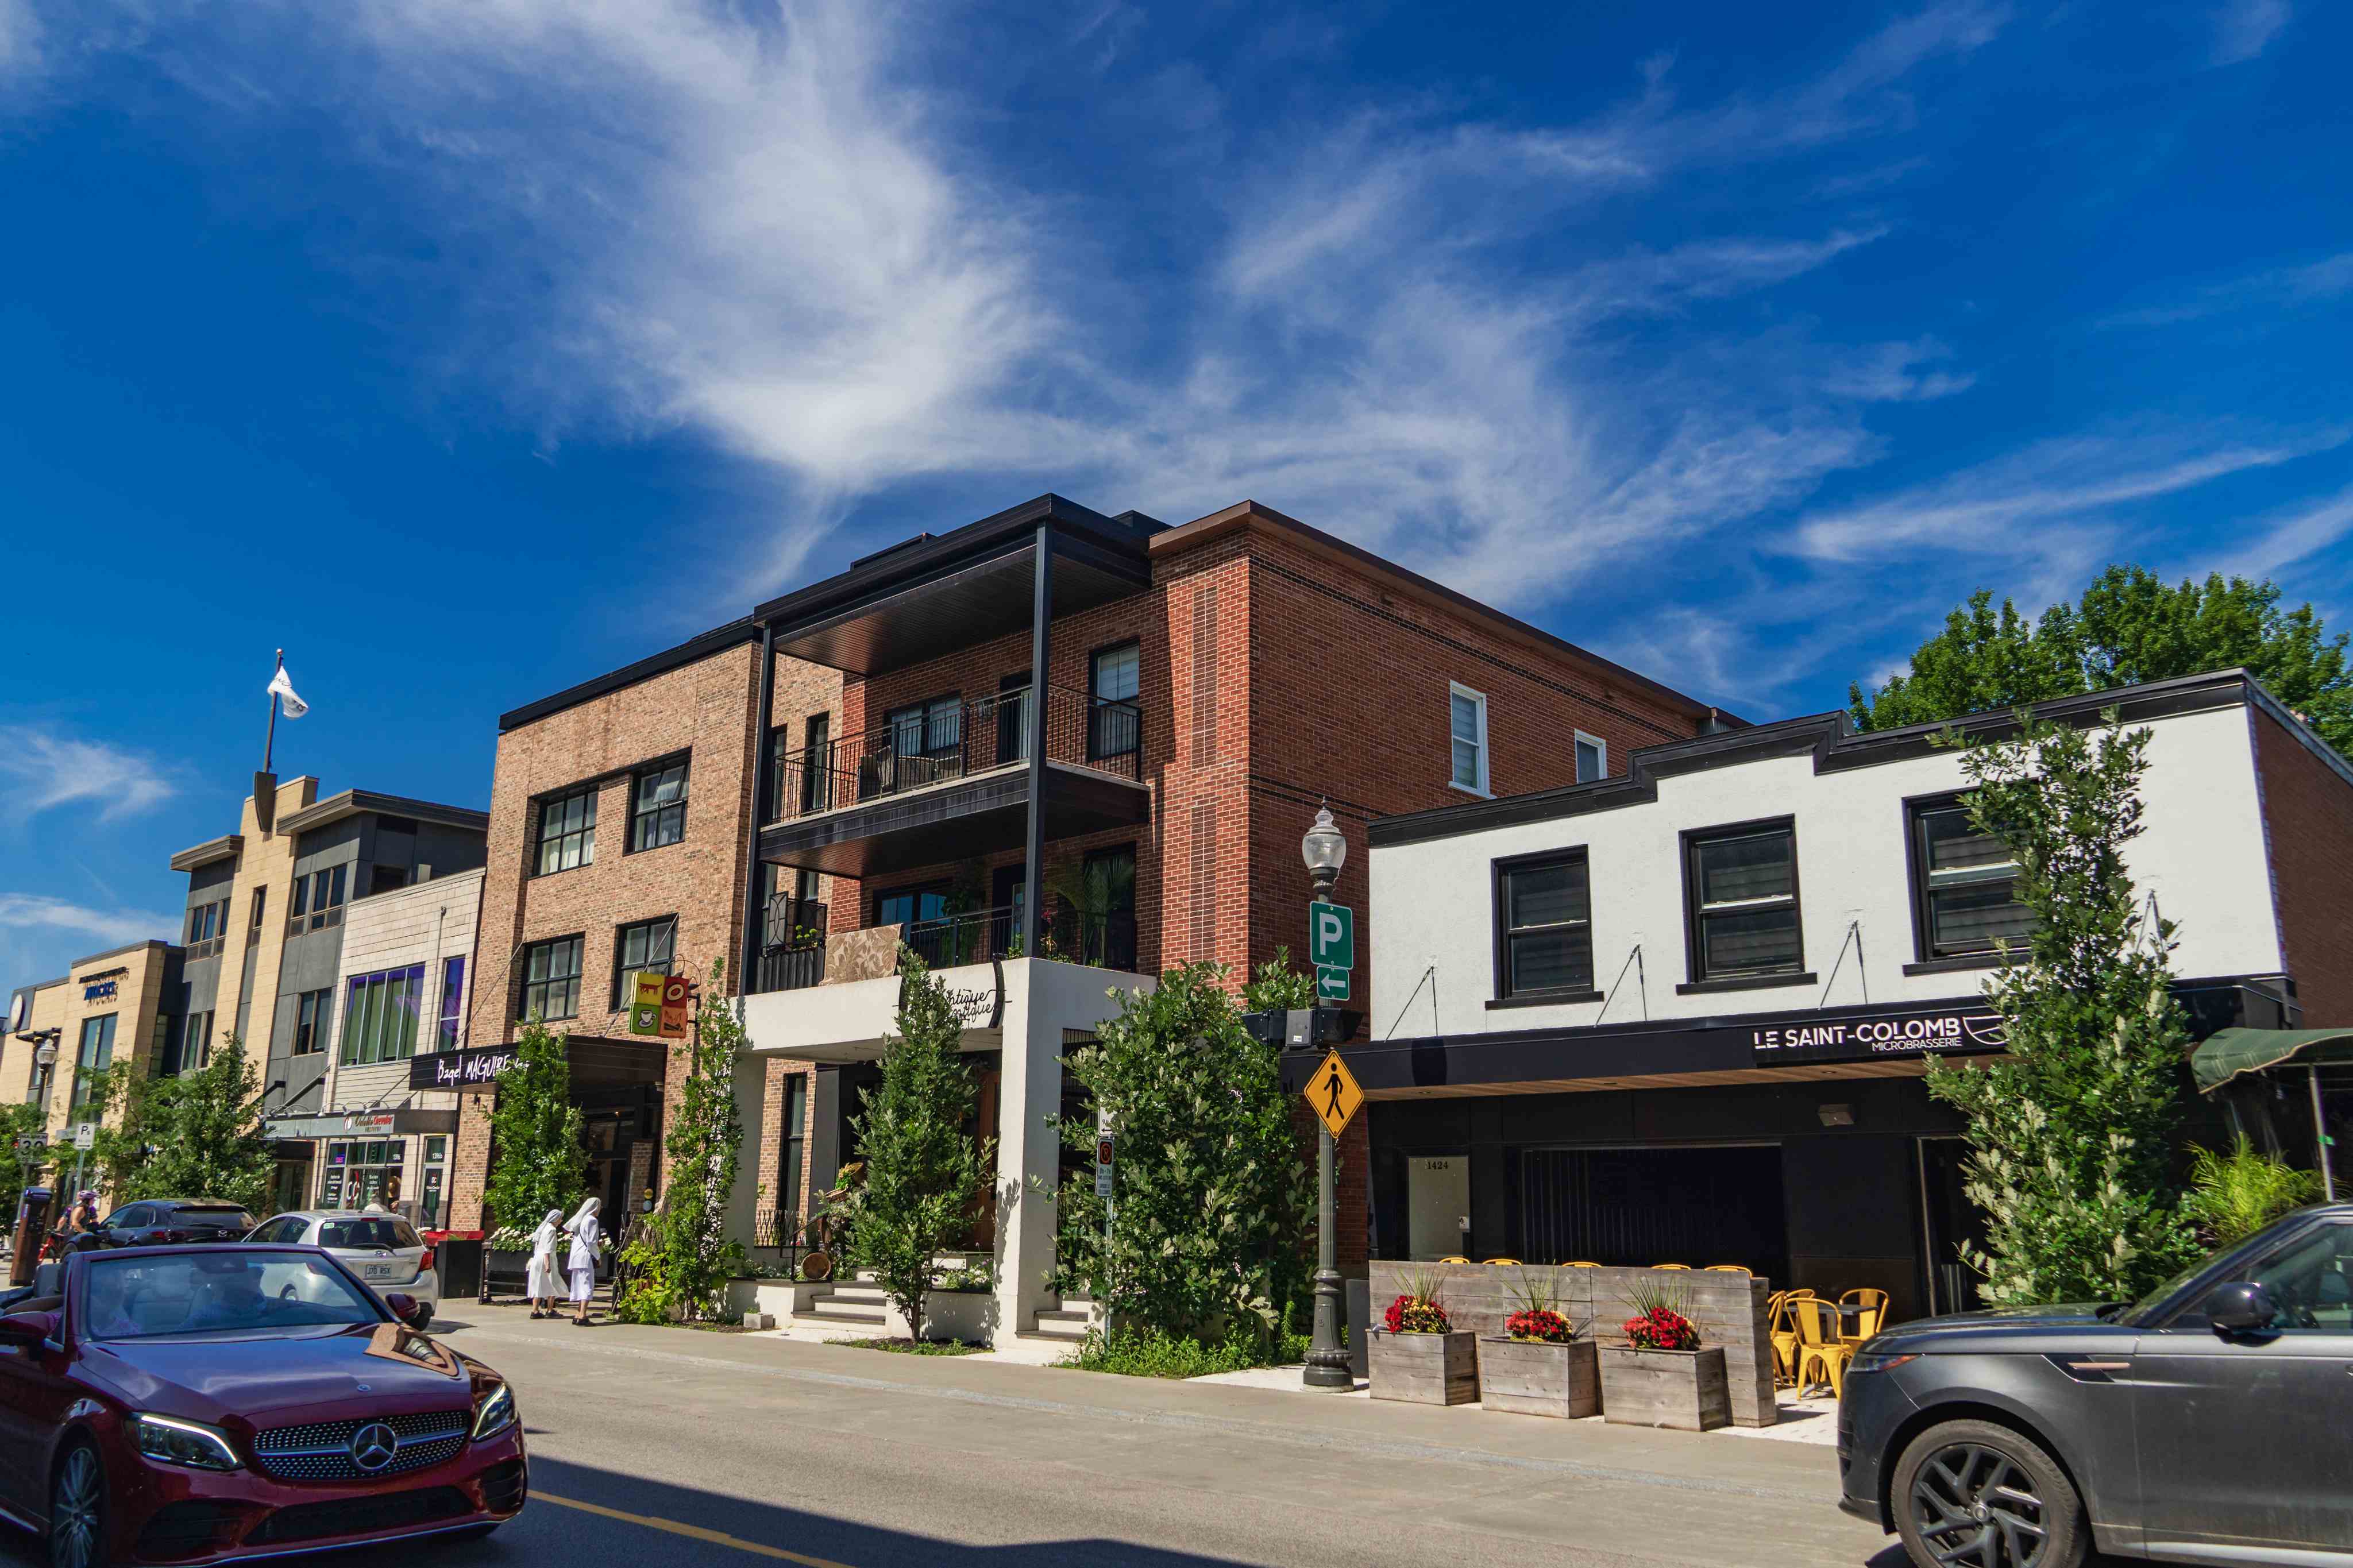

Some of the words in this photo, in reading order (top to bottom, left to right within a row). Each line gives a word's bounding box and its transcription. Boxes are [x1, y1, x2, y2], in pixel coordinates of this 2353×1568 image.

[1320, 913, 1343, 956] P
[1754, 1031, 1779, 1049] LE
[1785, 1018, 1961, 1047] SAINT-COLOMB
[1872, 1037, 1962, 1052] MICROBRASSERIE
[438, 1055, 462, 1087] Bagel
[465, 1055, 511, 1082] MAGUIRE
[1428, 1161, 1448, 1169] 1424
